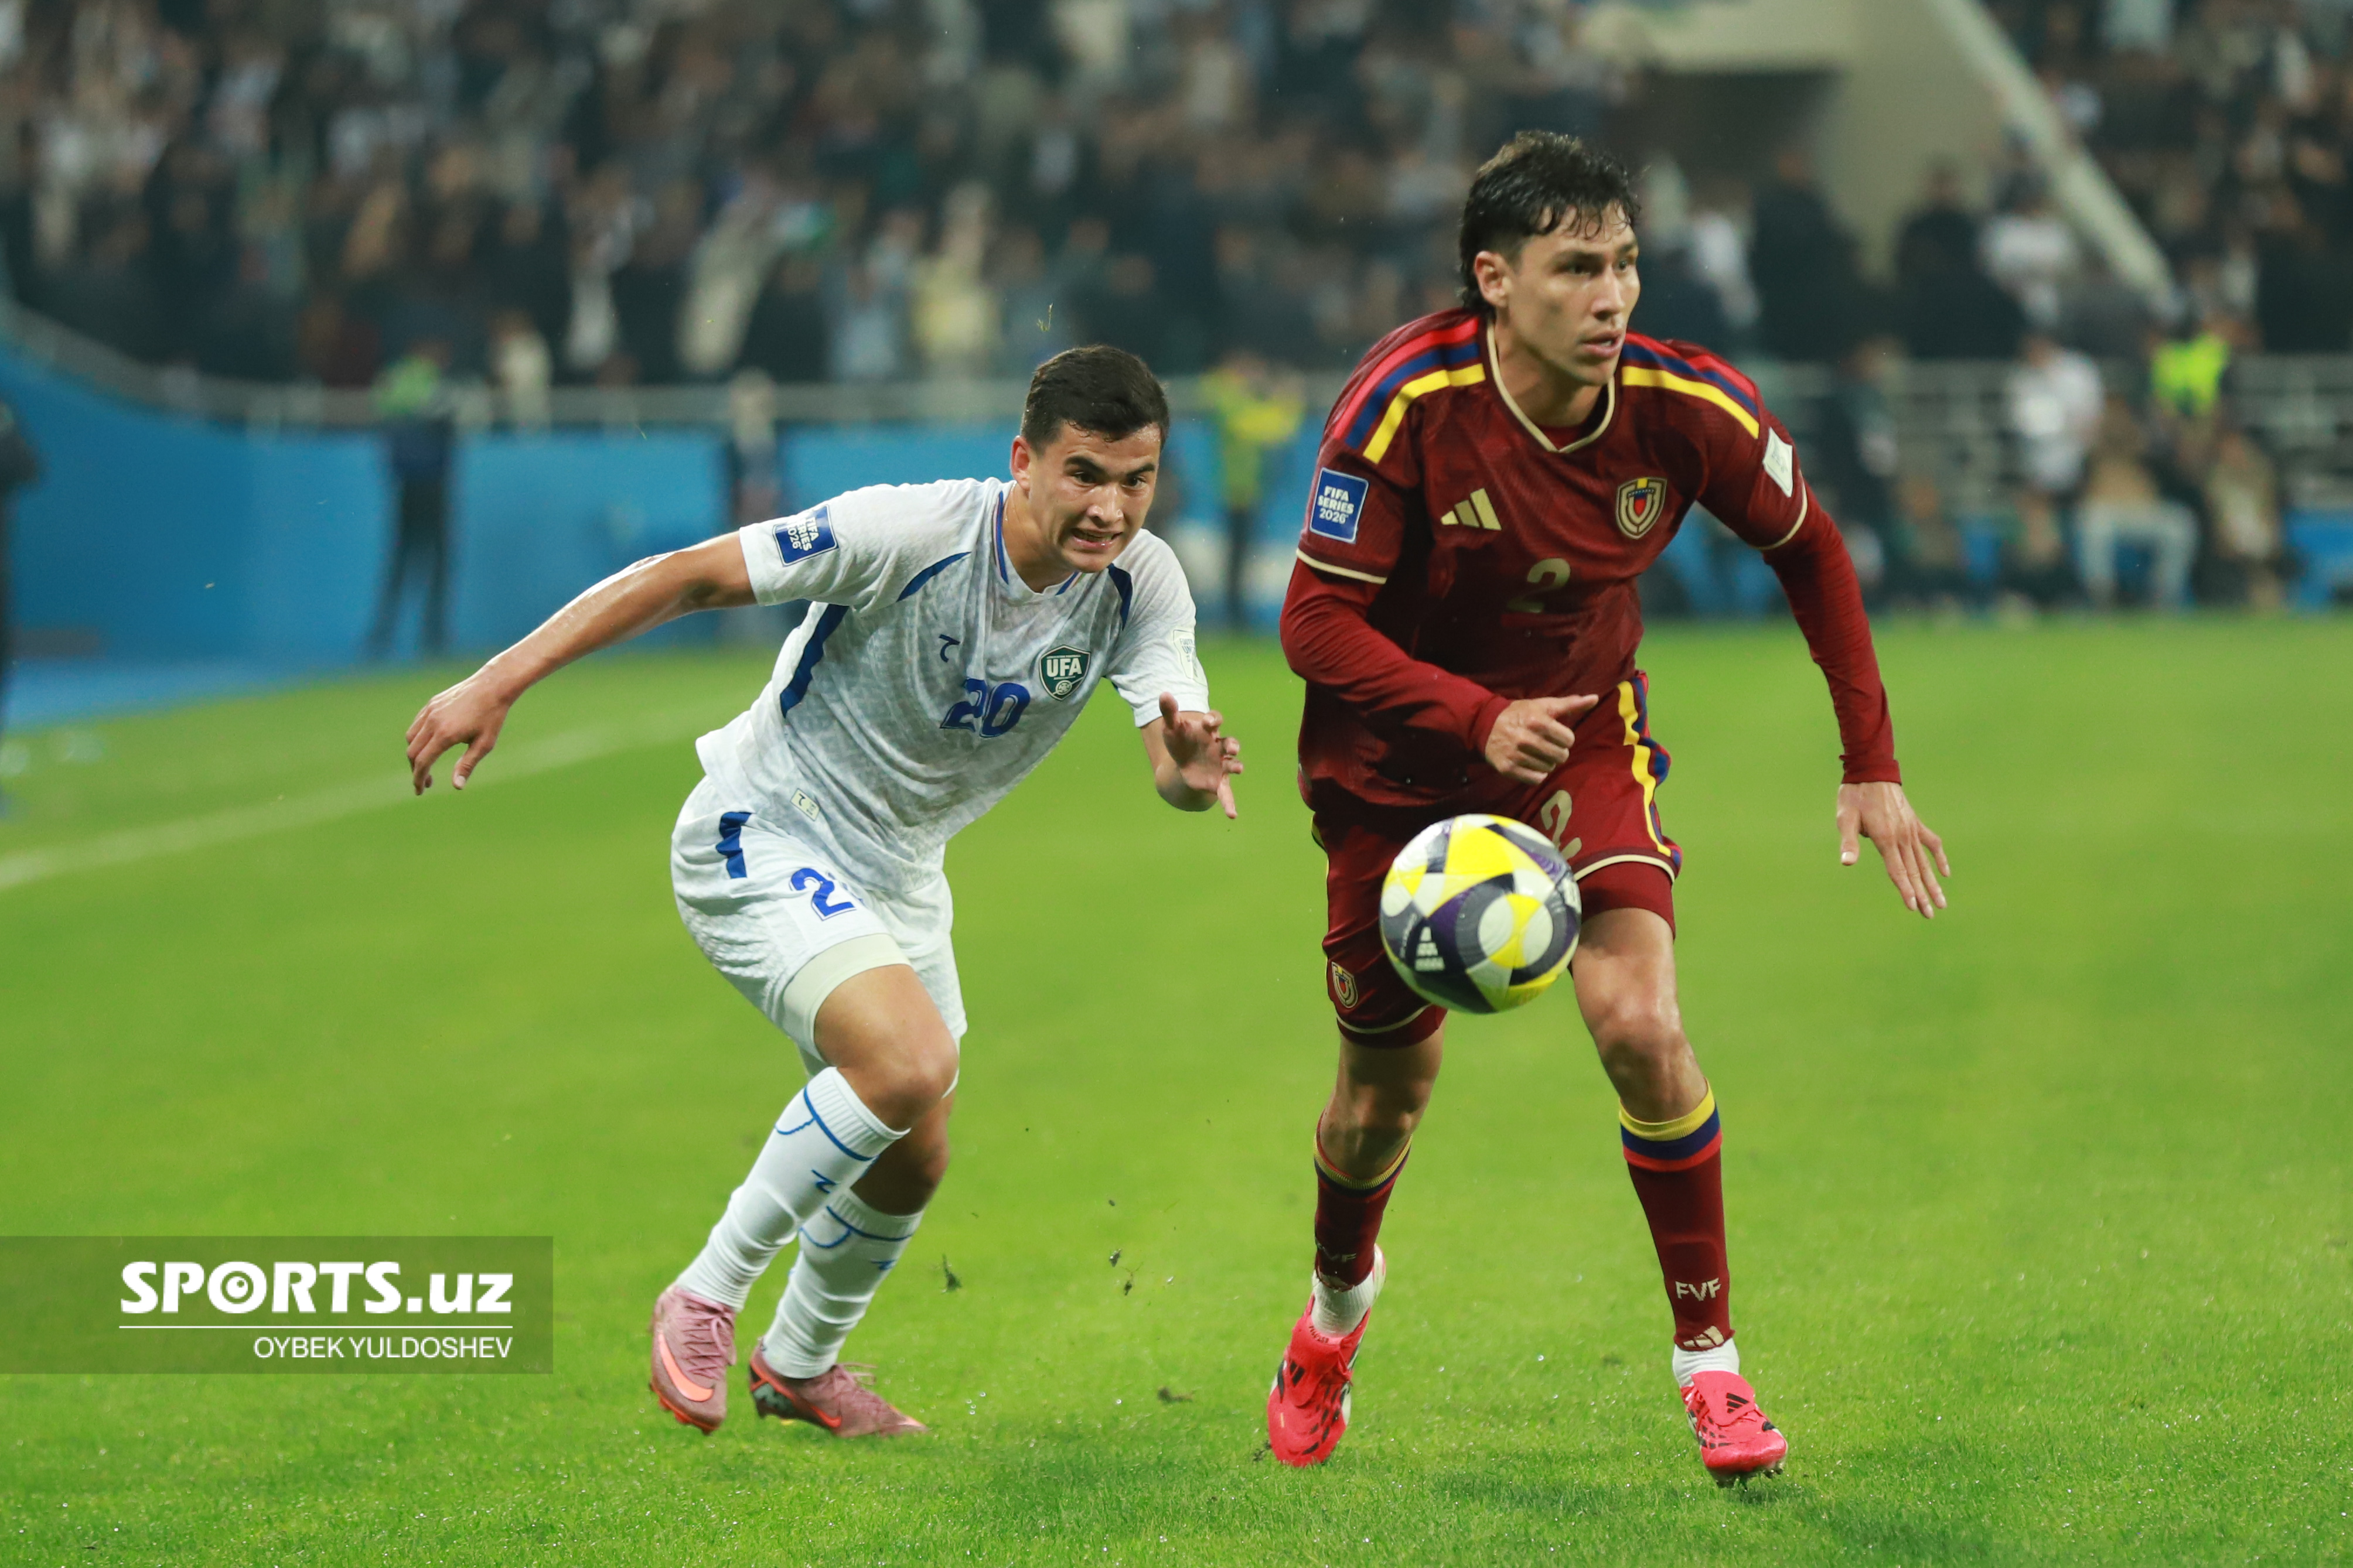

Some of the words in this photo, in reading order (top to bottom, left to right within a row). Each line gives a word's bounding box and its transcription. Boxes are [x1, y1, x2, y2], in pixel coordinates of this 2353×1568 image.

[1317, 495, 1355, 514] SERIES
[1324, 486, 1349, 502] FIFA
[1319, 508, 1346, 524] 2026
[787, 527, 801, 549] 026
[797, 519, 813, 551] ERIES
[1506, 558, 1571, 613] 2
[1046, 657, 1082, 677] UFA
[939, 677, 1031, 738] 20
[1540, 790, 1582, 861] 2
[789, 867, 865, 921] 2
[1675, 1277, 1722, 1301] FVF
